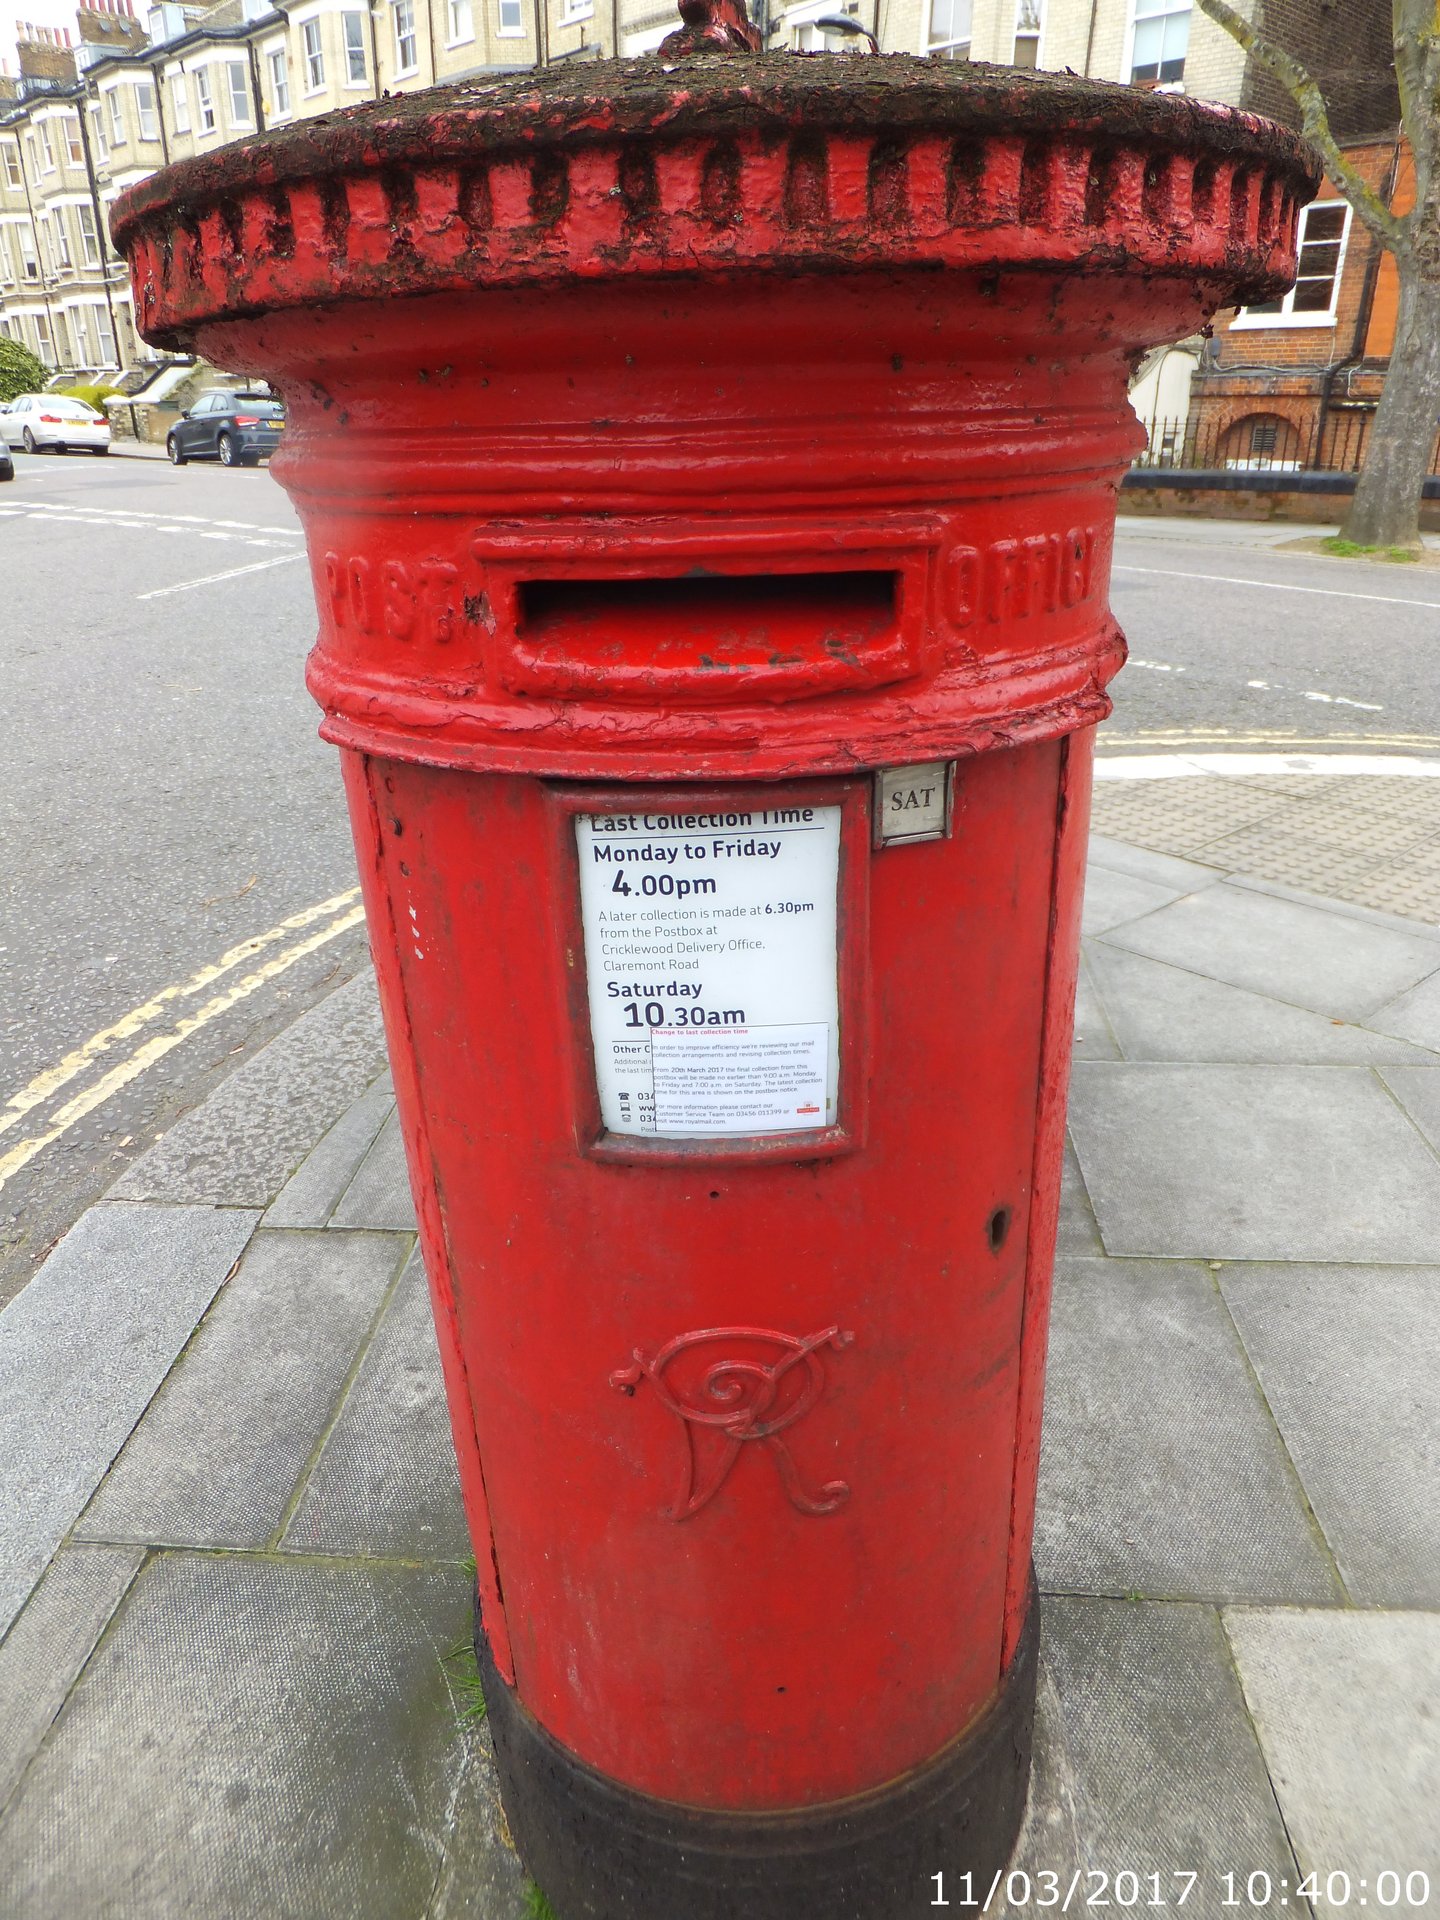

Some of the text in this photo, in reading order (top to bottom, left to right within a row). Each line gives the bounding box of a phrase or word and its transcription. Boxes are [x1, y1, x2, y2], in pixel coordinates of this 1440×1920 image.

[324, 550, 459, 645] POST
[891, 787, 935, 812] SAT
[592, 808, 814, 832] Last Collection Time
[594, 840, 781, 863] Monday to Friday
[612, 871, 716, 898] 4.00pm
[599, 901, 814, 922] A later collection is made at 6.30pm
[600, 926, 717, 938] from the Postbox at
[602, 942, 673, 954] Cricklewood
[677, 941, 725, 953] Delivery
[604, 959, 699, 971] Claremont Road
[607, 982, 702, 999] Saturday
[624, 1003, 745, 1027] 10.30am
[613, 1045, 641, 1053] Other
